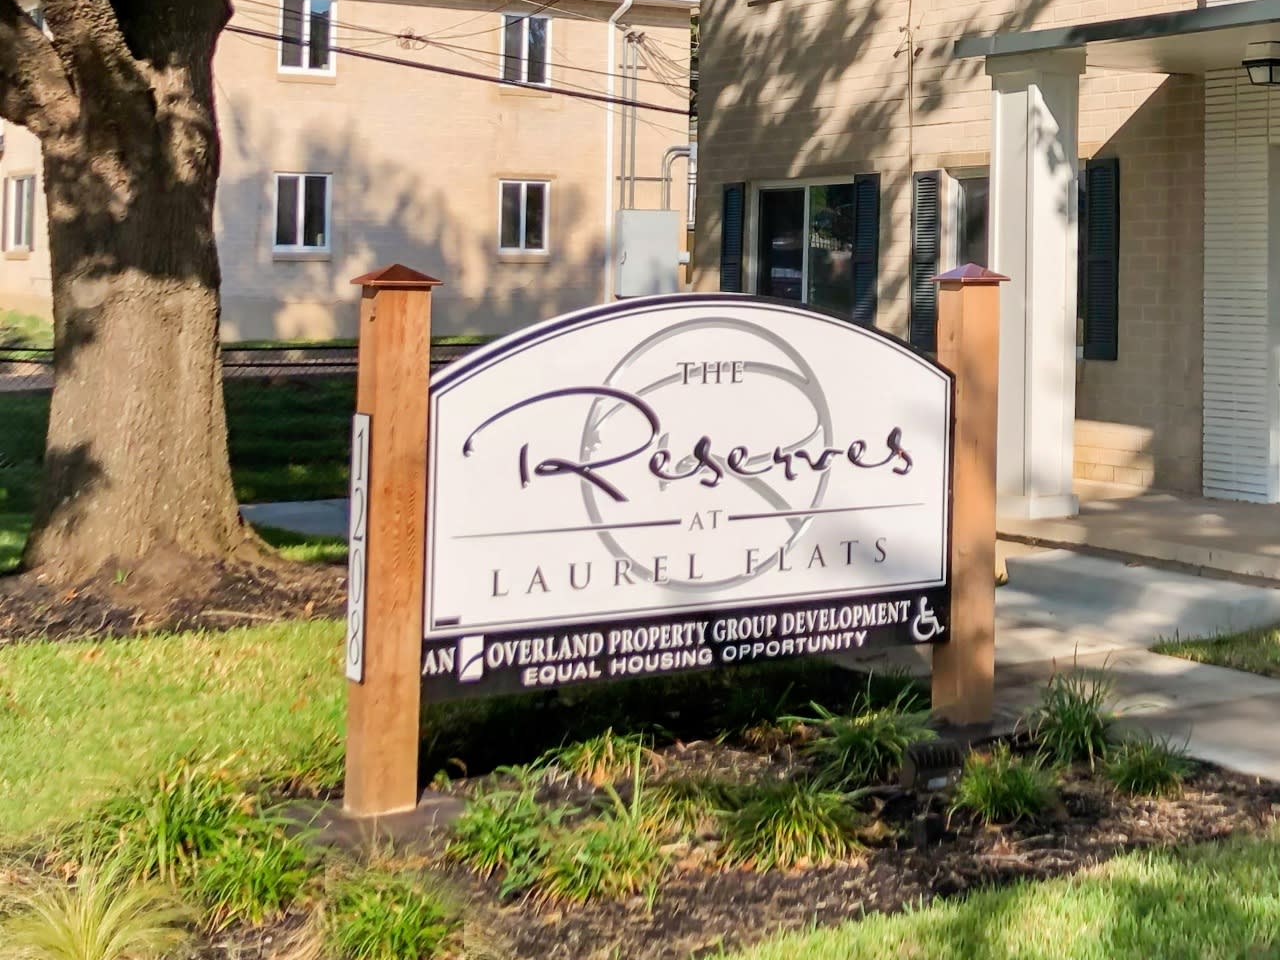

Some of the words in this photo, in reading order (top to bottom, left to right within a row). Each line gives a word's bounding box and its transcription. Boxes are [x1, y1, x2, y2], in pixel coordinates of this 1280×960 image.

[677, 360, 744, 385] THE
[462, 385, 914, 502] Reserves
[350, 428, 365, 666] 1208
[688, 510, 723, 531] AT
[491, 552, 704, 597] LAUREL
[745, 537, 889, 575] FLATS
[422, 647, 456, 676] AN
[486, 631, 604, 669] OVERLAND
[607, 621, 708, 656] PROPERTY
[713, 612, 777, 641] GROUP
[780, 600, 911, 635] DEVELOPMENT
[523, 662, 602, 686] EQUAL
[610, 648, 713, 676] HOUSING
[722, 630, 868, 663] OPPORTUNITY
